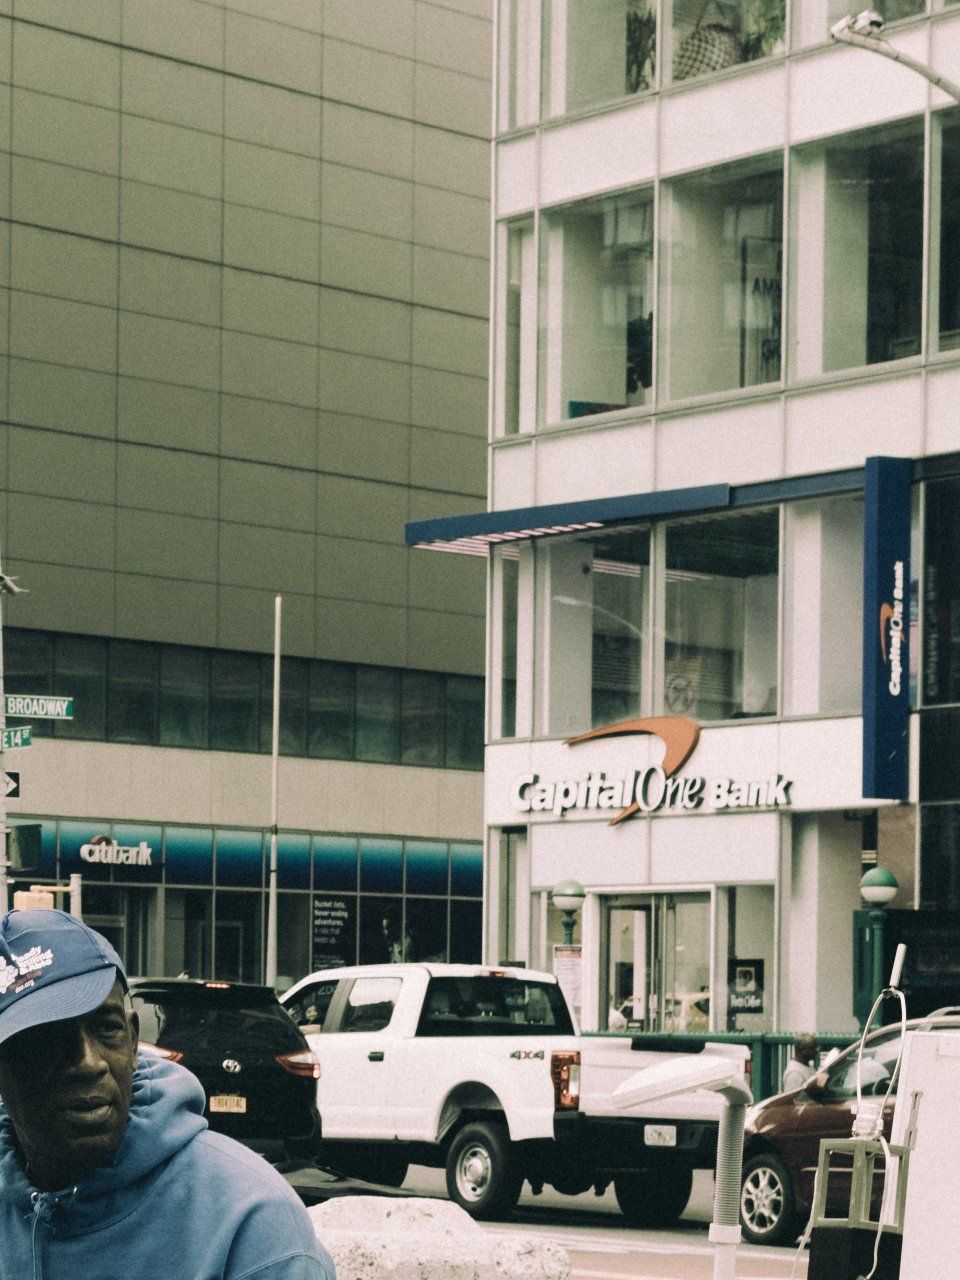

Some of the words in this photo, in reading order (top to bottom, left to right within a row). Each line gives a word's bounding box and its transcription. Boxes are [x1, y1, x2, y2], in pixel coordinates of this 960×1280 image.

[894, 561, 903, 599] Bank
[7, 698, 68, 716] BROADWAY
[10, 732, 22, 747] 14
[707, 774, 794, 808] Bank
[80, 840, 152, 866] citibank
